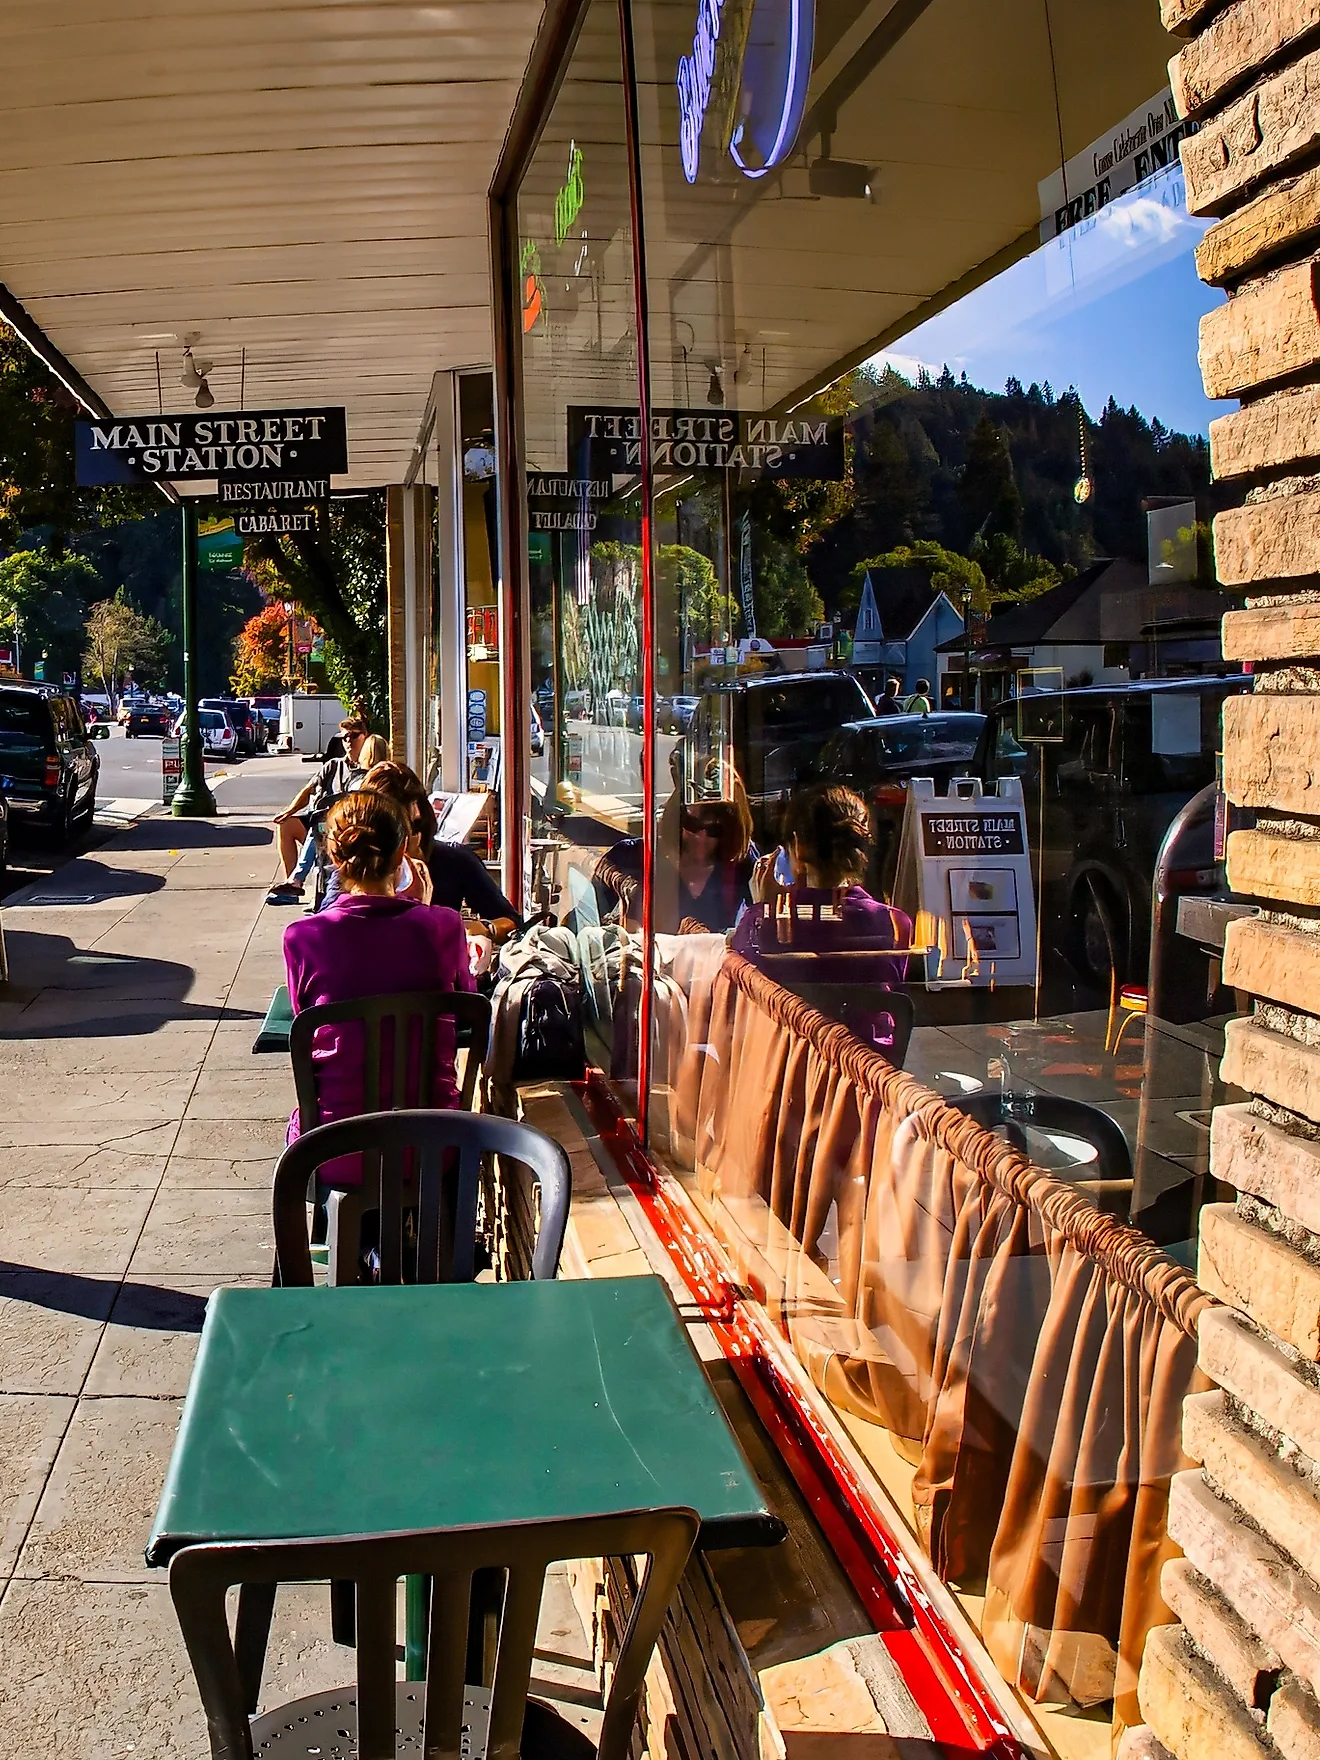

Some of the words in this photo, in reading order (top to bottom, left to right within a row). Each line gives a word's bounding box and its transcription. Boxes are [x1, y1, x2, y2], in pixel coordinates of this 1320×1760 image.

[1055, 175, 1113, 235] FREE
[90, 422, 181, 451] MAIN
[194, 416, 326, 445] STREET
[142, 443, 285, 473] STATION
[221, 480, 328, 502] RESTAURANT
[238, 513, 312, 533] CABARET
